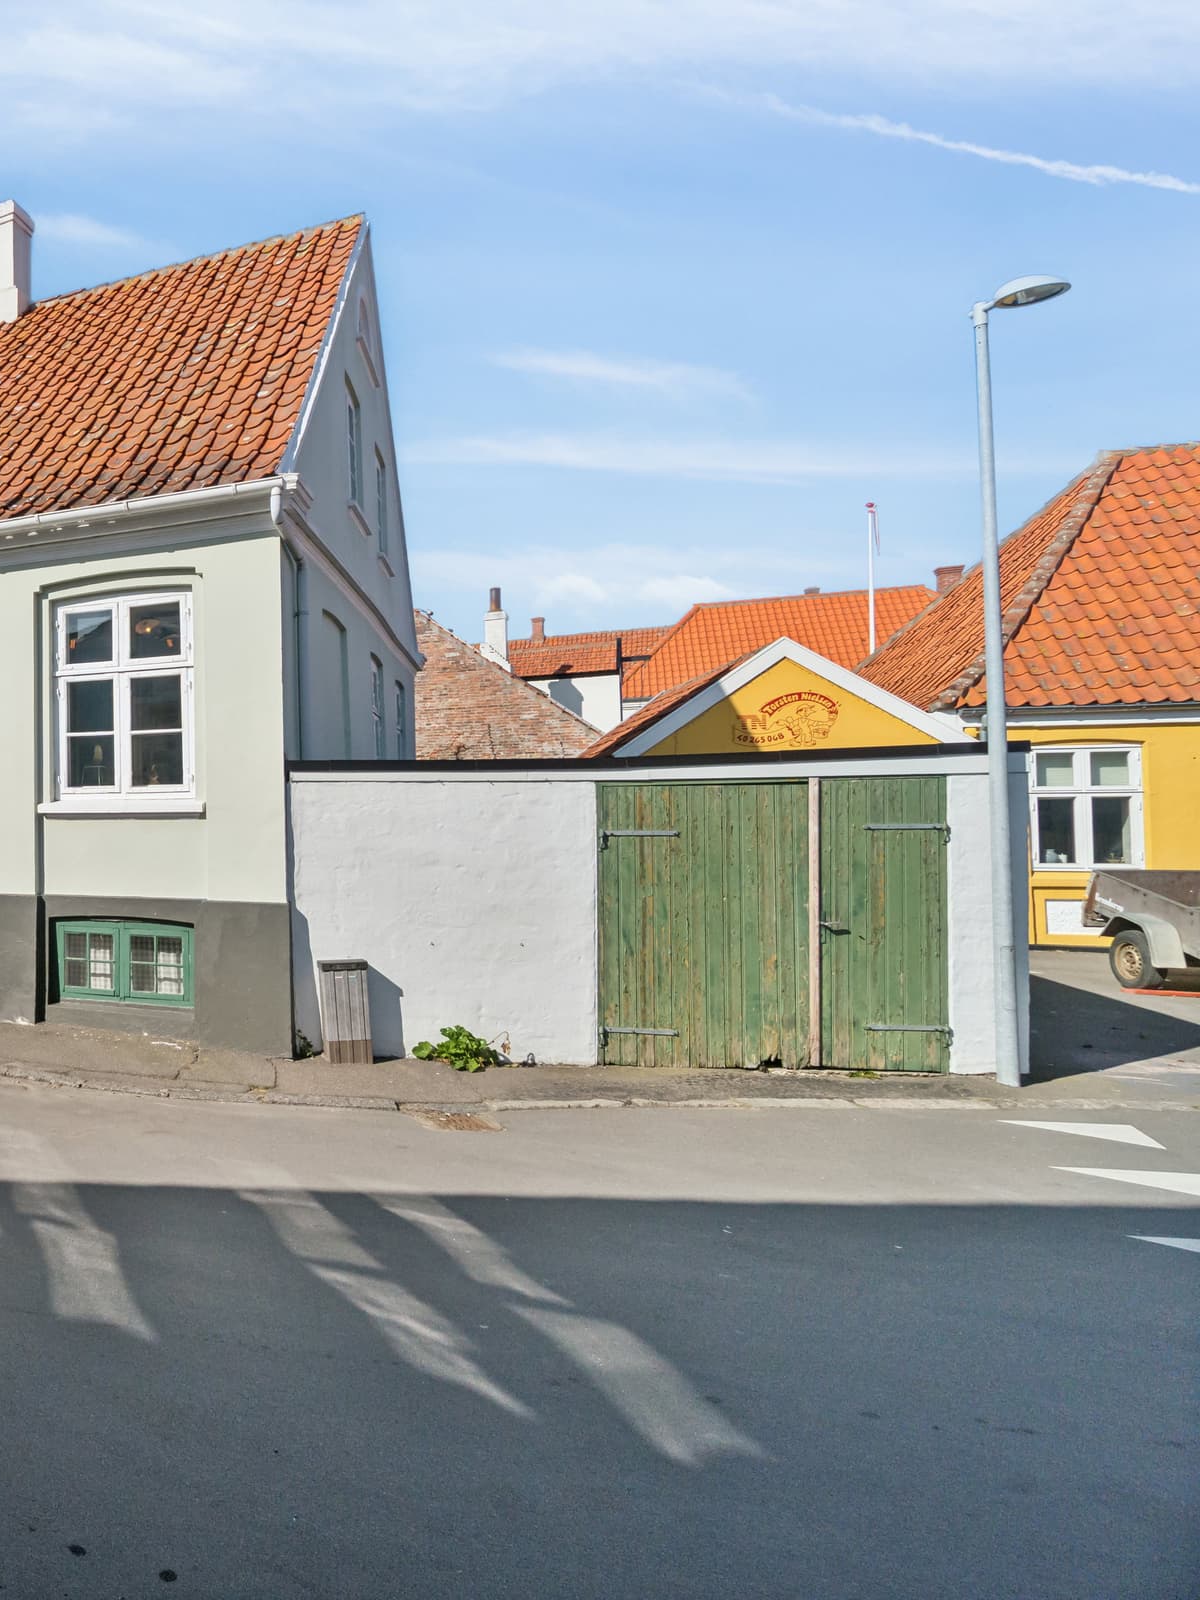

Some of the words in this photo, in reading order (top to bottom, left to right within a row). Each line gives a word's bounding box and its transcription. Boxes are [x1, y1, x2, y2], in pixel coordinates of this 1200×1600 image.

[763, 694, 799, 713] Torsten
[801, 692, 833, 708] Nielsen
[737, 714, 767, 730] TN
